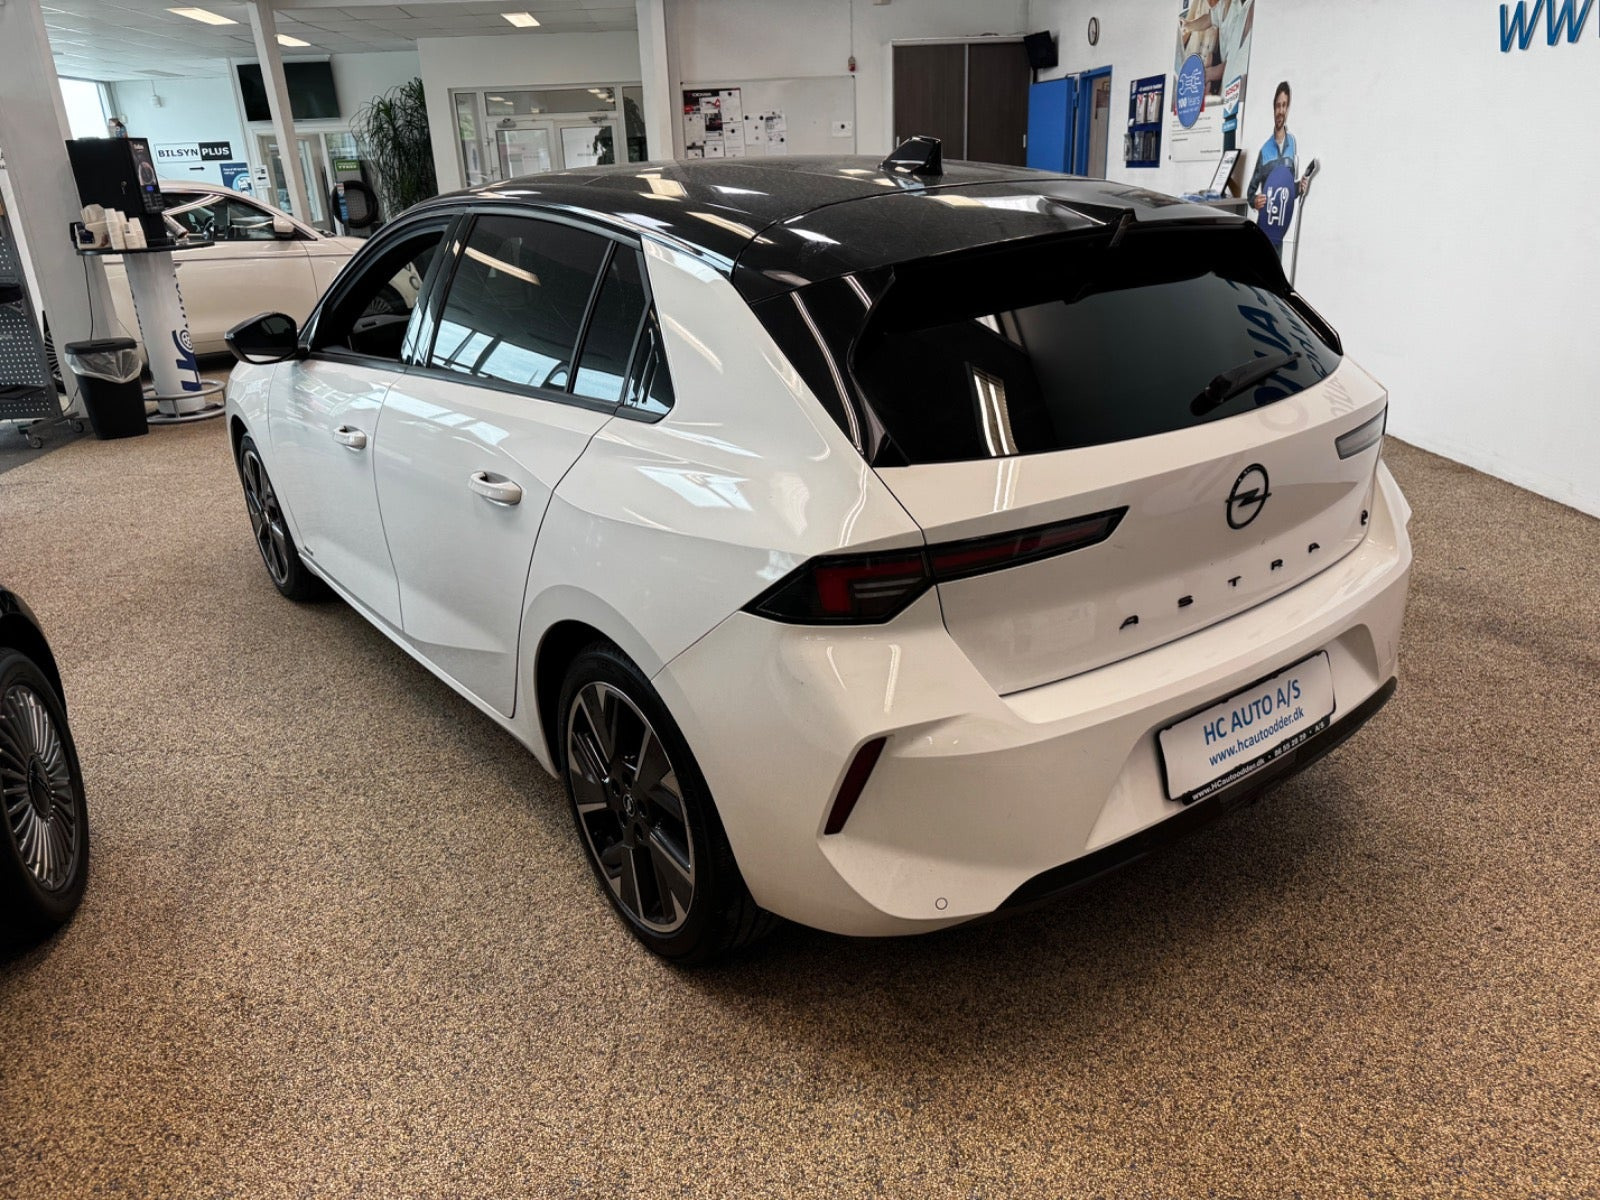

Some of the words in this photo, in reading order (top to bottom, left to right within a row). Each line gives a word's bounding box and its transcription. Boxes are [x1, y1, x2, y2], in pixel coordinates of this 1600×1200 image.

[158, 148, 198, 158] BILSYN
[201, 147, 230, 157] PLUS
[1119, 542, 1320, 630] ASTRA
[1203, 717, 1228, 746] HC
[1231, 694, 1273, 733] AUTO
[1276, 679, 1301, 708] A/S
[1208, 706, 1305, 766] www.hcautoodder.dk
[1191, 758, 1265, 800] www.HCautoodder.dk
